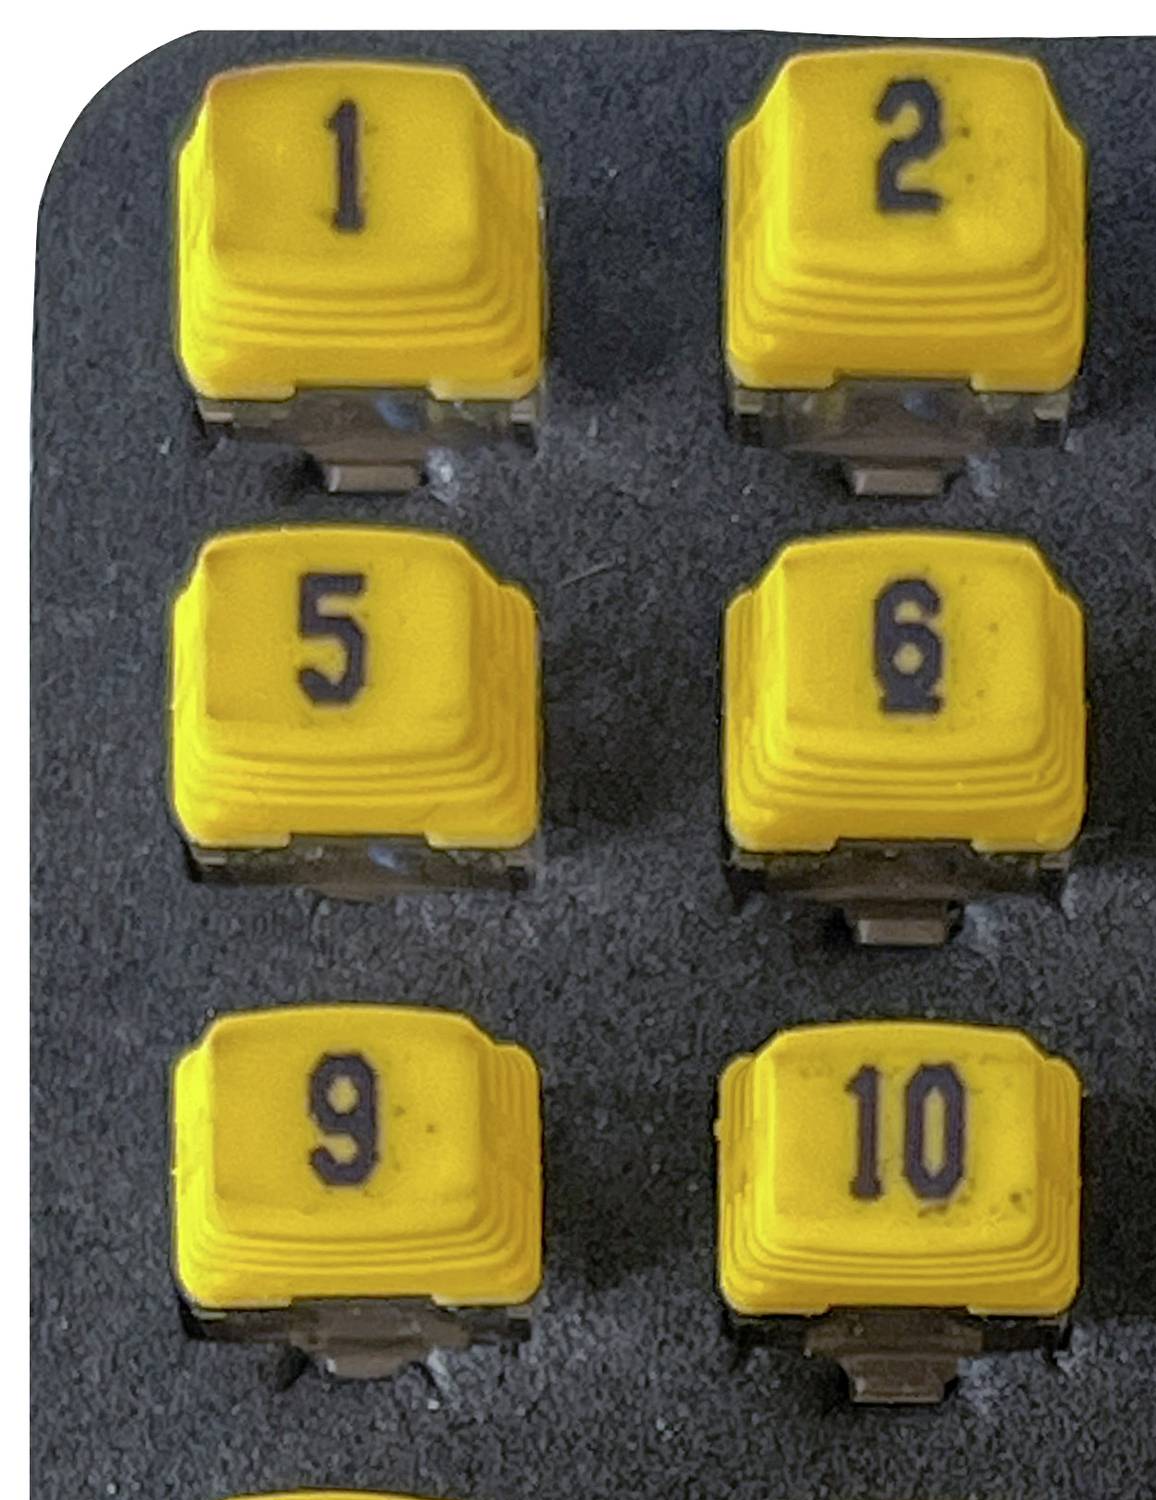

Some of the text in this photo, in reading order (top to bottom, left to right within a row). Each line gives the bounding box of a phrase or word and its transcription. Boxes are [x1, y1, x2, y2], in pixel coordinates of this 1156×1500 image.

[324, 99, 366, 234] 1
[873, 75, 946, 216] 2
[297, 571, 368, 707] 5
[872, 576, 944, 716] 6
[307, 1051, 381, 1188] 9
[845, 1061, 968, 1202] 10
